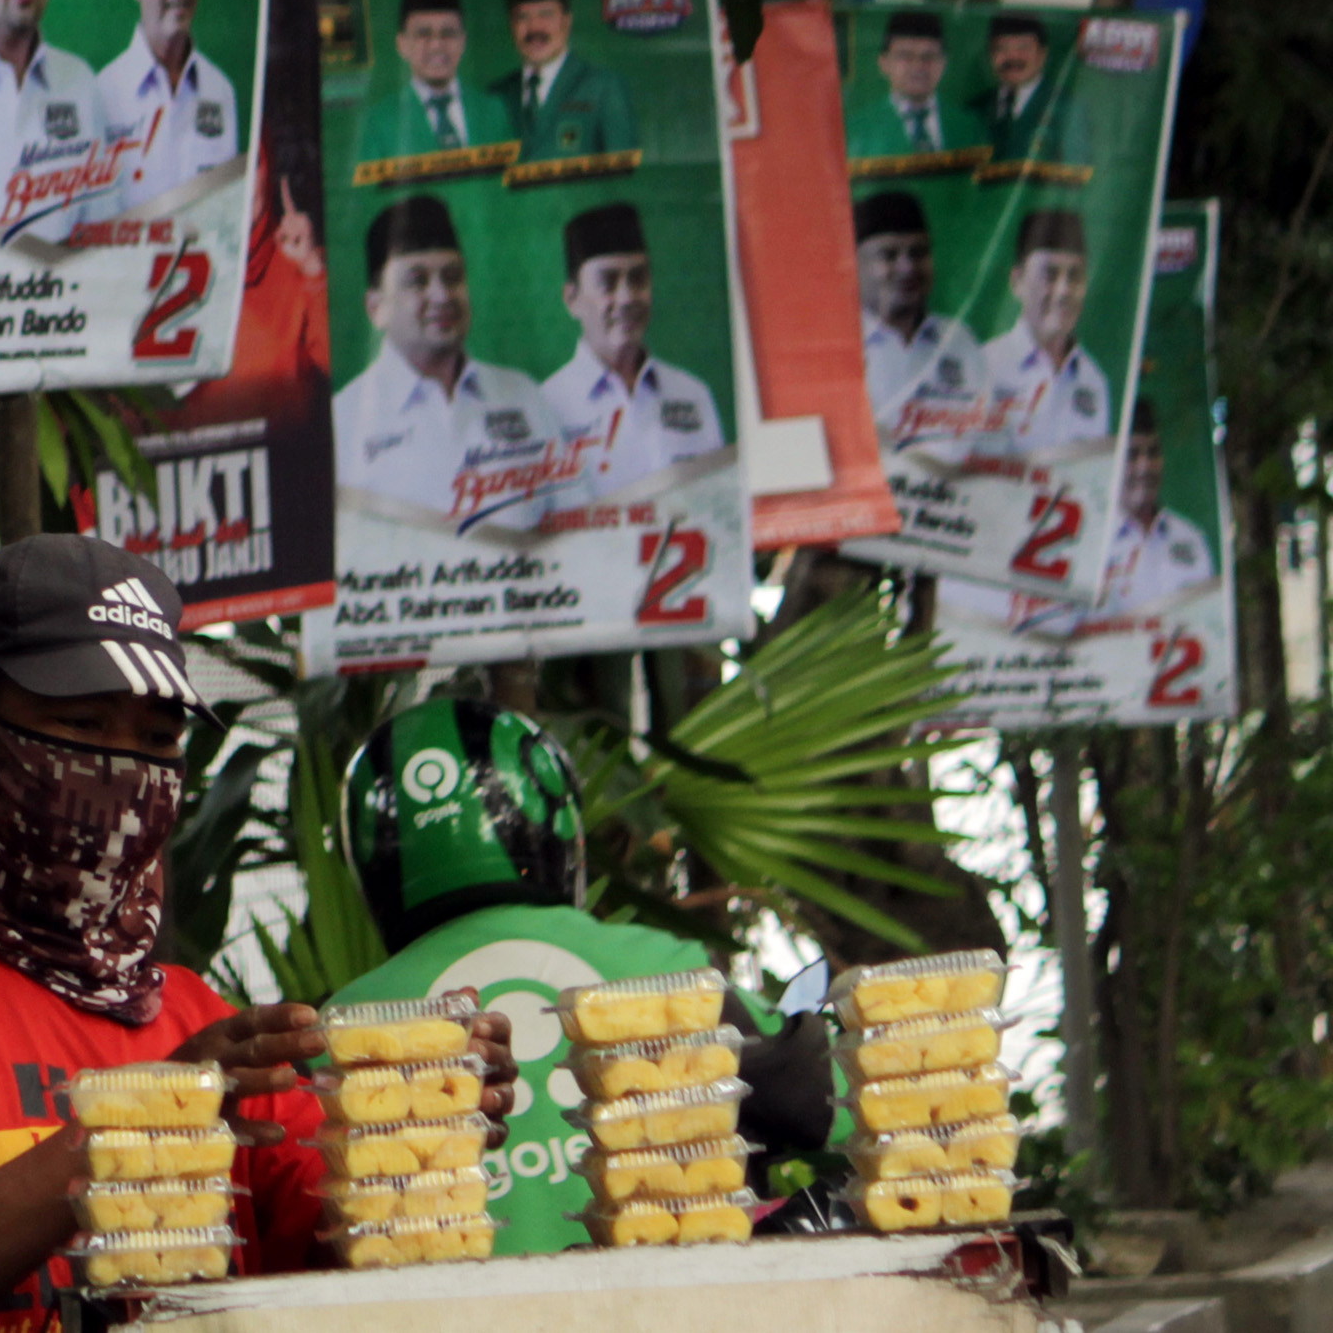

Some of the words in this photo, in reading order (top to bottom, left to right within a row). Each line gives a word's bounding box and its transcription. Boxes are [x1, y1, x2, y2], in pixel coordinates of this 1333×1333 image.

[21, 306, 86, 336] Bando
[132, 252, 211, 361] 2
[1011, 494, 1083, 581] 2
[635, 529, 709, 627] 2
[88, 604, 173, 641] adidas
[1147, 637, 1204, 708] 2
